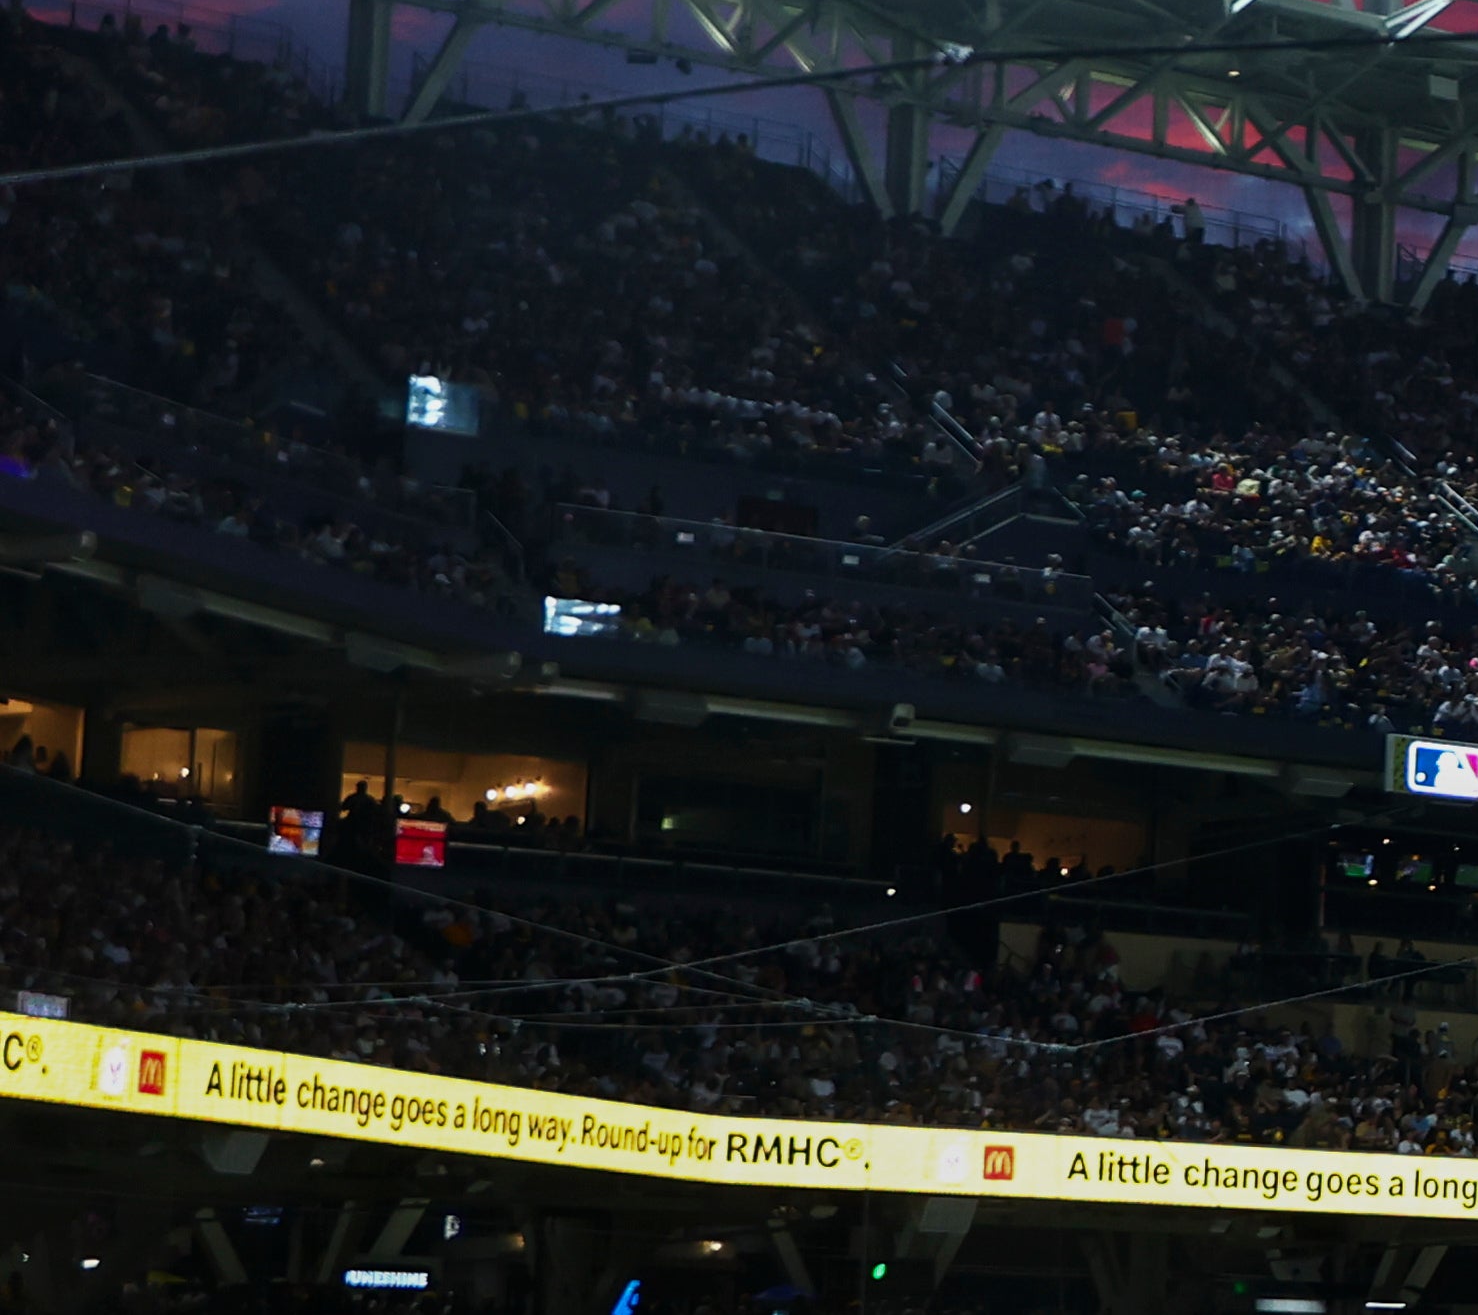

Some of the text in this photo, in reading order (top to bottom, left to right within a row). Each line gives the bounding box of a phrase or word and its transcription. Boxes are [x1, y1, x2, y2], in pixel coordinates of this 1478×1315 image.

[206, 1061, 223, 1096] A
[229, 1062, 286, 1105] little
[297, 1072, 388, 1127] change
[391, 1093, 448, 1140] goes
[454, 1105, 466, 1130] a
[472, 1097, 520, 1146] long
[528, 1110, 576, 1150] way.
[581, 1114, 682, 1167] Round-up
[688, 1126, 717, 1160] for
[1067, 1151, 1089, 1180] A
[1098, 1151, 1170, 1185] little
[1183, 1158, 1298, 1199] change
[1306, 1169, 1379, 1202] goes
[1388, 1175, 1405, 1197] a
[1413, 1171, 1478, 1208] long
